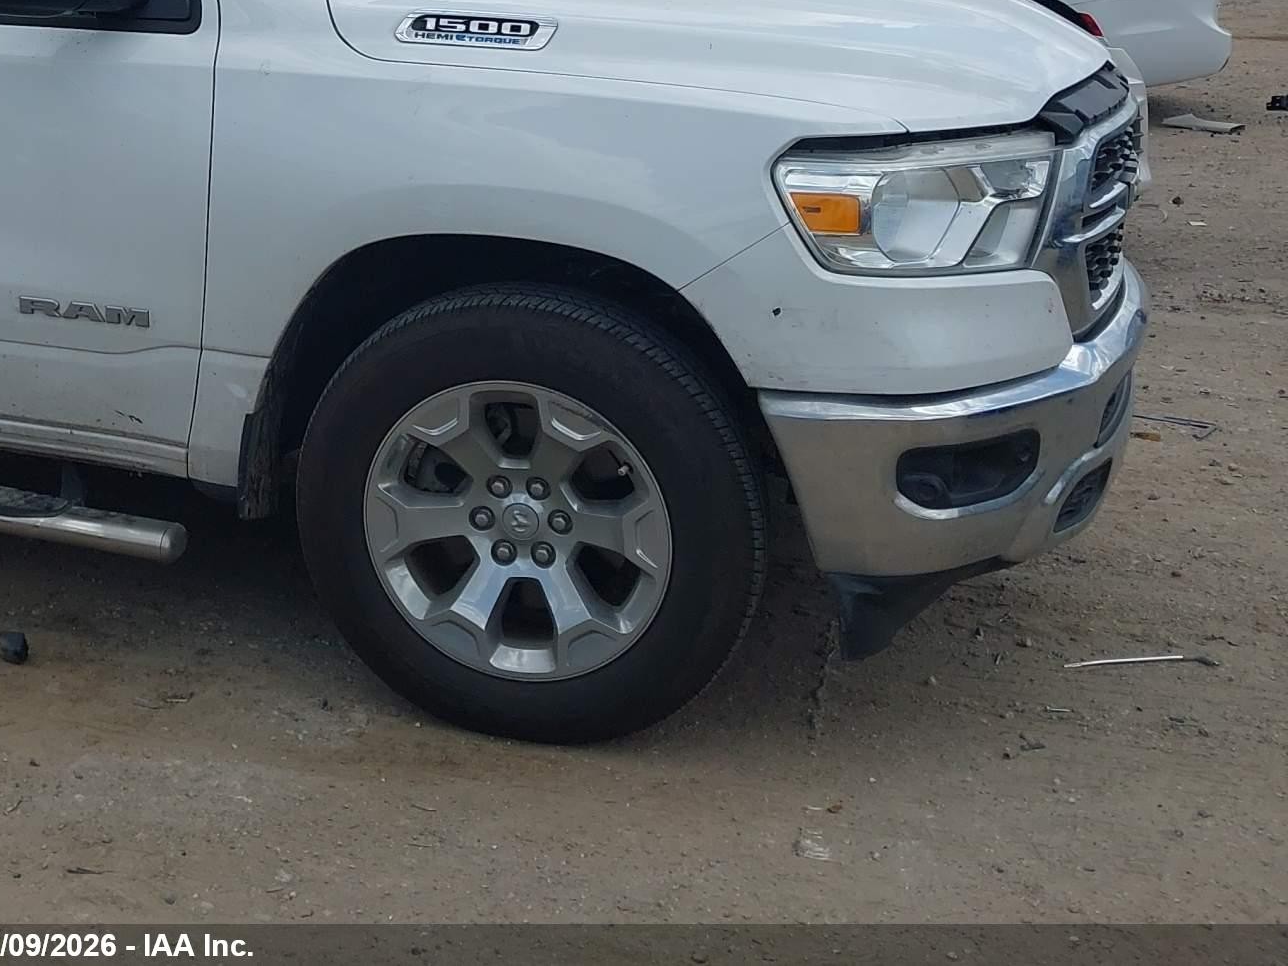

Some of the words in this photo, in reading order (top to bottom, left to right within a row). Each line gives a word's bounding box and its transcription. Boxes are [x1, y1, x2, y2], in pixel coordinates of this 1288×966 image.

[423, 17, 531, 36] 1500
[414, 32, 453, 41] HEMI
[18, 295, 151, 329] RAM
